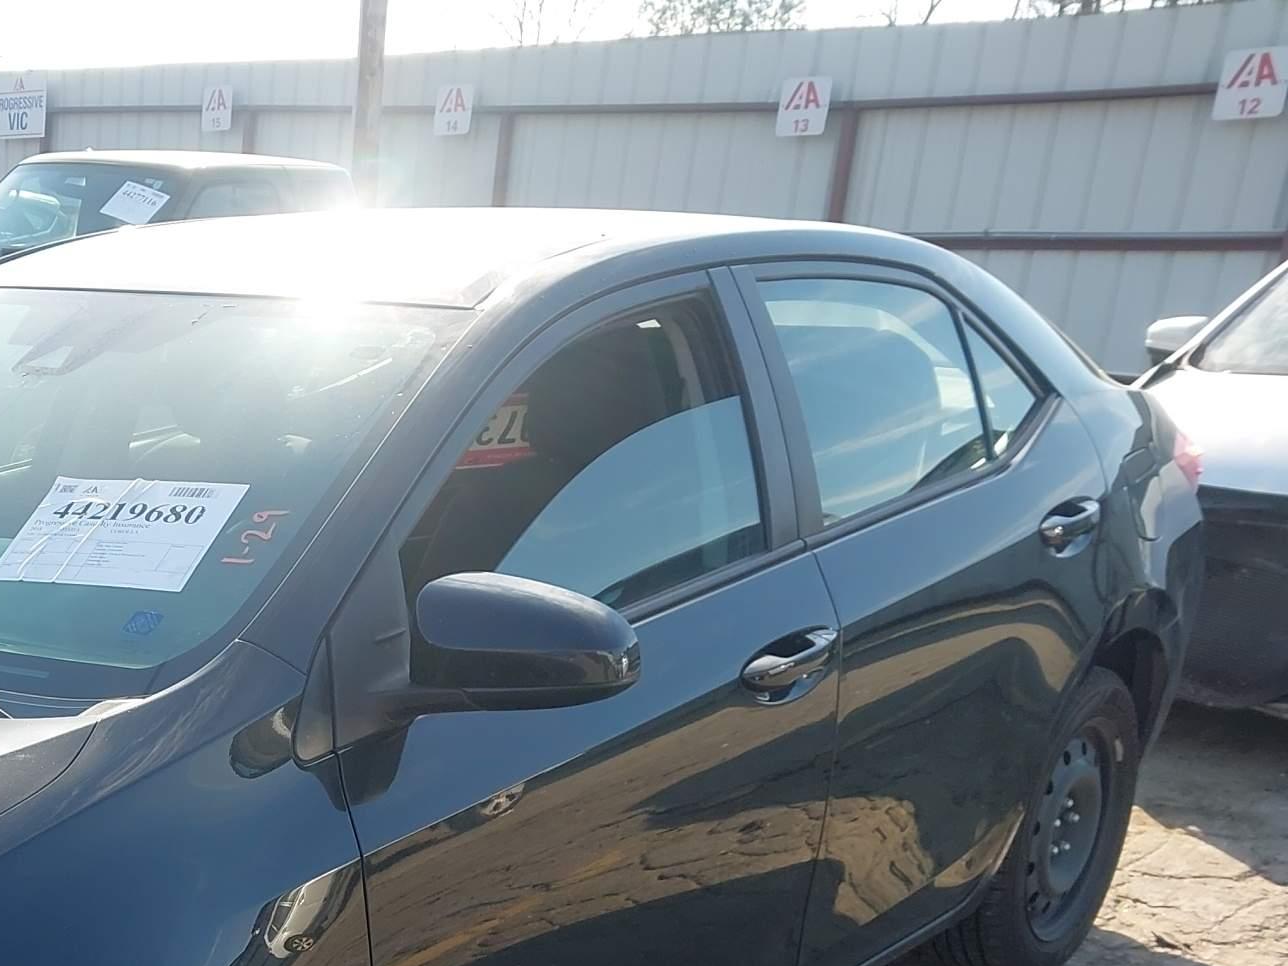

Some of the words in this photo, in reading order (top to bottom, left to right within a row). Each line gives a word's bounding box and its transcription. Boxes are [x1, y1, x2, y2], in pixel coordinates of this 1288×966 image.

[1239, 97, 1262, 115] 12
[8, 112, 29, 130] VIC
[211, 117, 222, 129] 15
[446, 119, 458, 132] 14
[793, 118, 809, 133] 13
[53, 501, 206, 525] 44219680
[220, 510, 291, 564] 1-29
